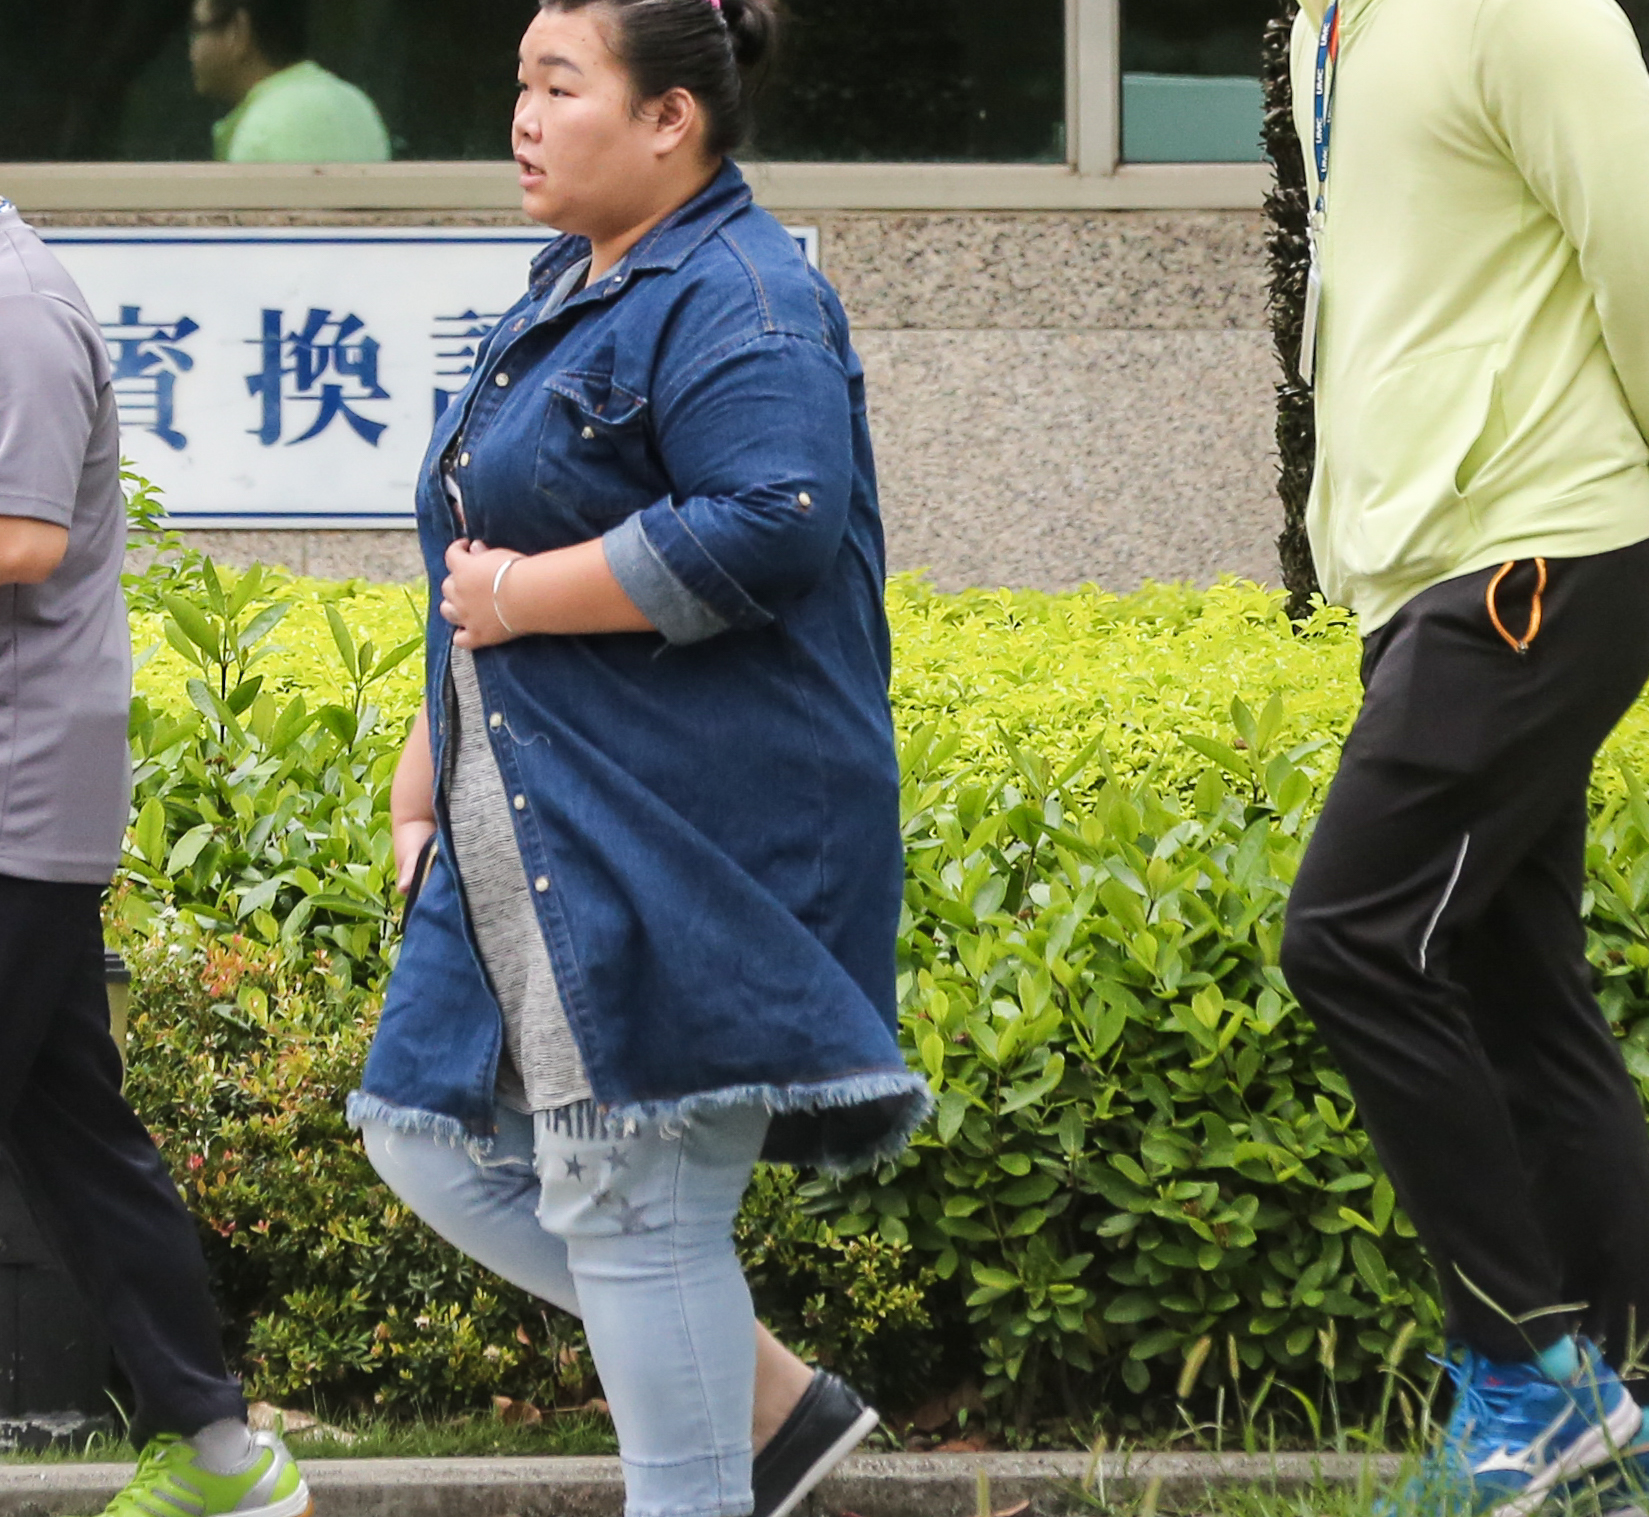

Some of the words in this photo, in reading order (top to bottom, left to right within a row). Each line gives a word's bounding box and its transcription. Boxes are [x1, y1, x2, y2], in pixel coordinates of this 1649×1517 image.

[1319, 22, 1332, 47] UMC
[1315, 68, 1325, 96] UMC
[1315, 117, 1324, 144] UMC
